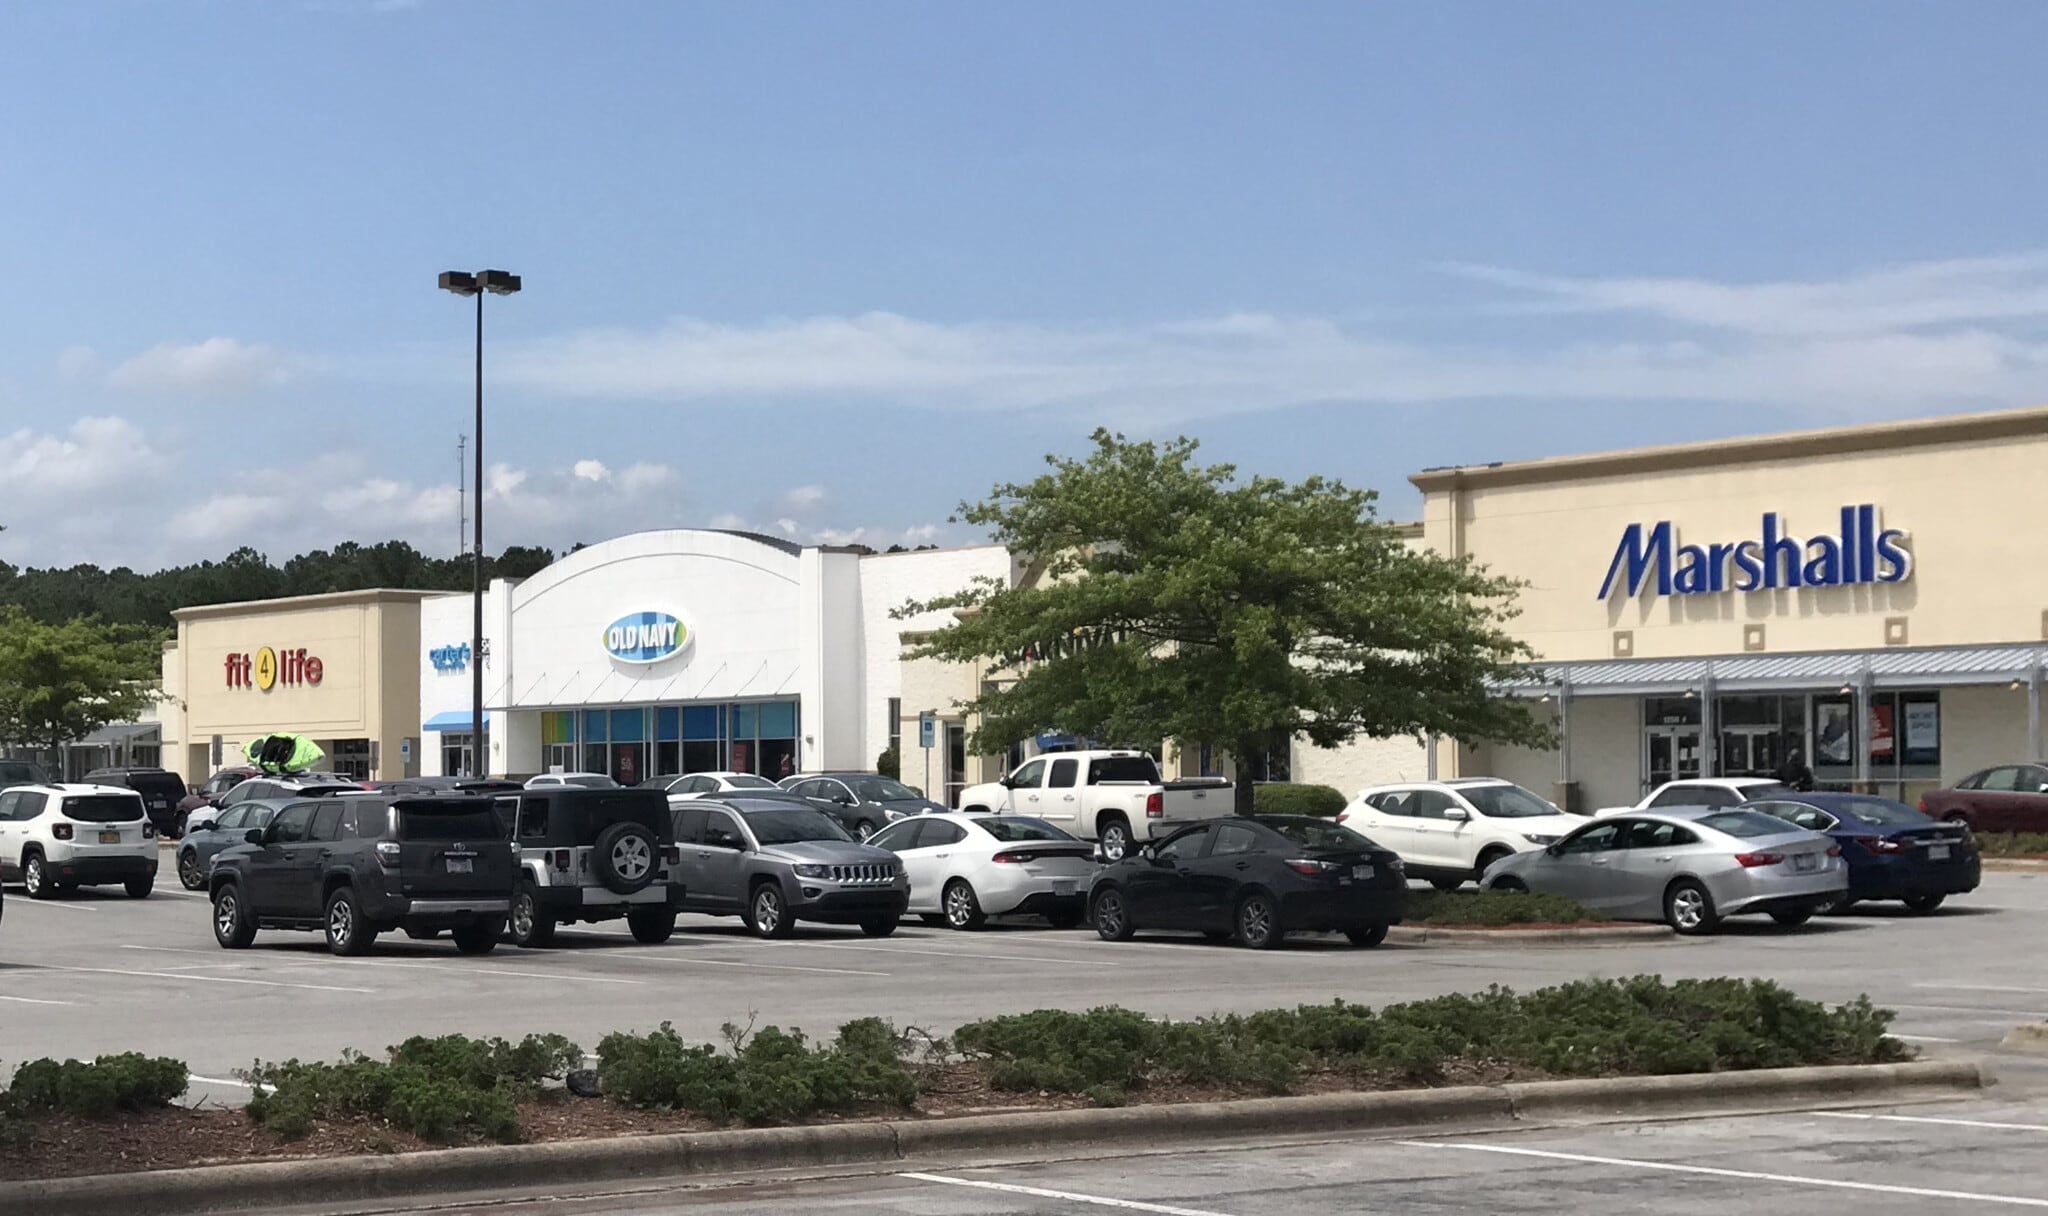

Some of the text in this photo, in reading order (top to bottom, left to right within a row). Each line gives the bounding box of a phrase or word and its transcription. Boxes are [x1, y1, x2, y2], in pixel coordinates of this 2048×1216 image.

[1597, 503, 1913, 600] Marshalls
[609, 622, 677, 650] OLD NAVY
[224, 652, 252, 687] fit
[280, 648, 323, 685] life
